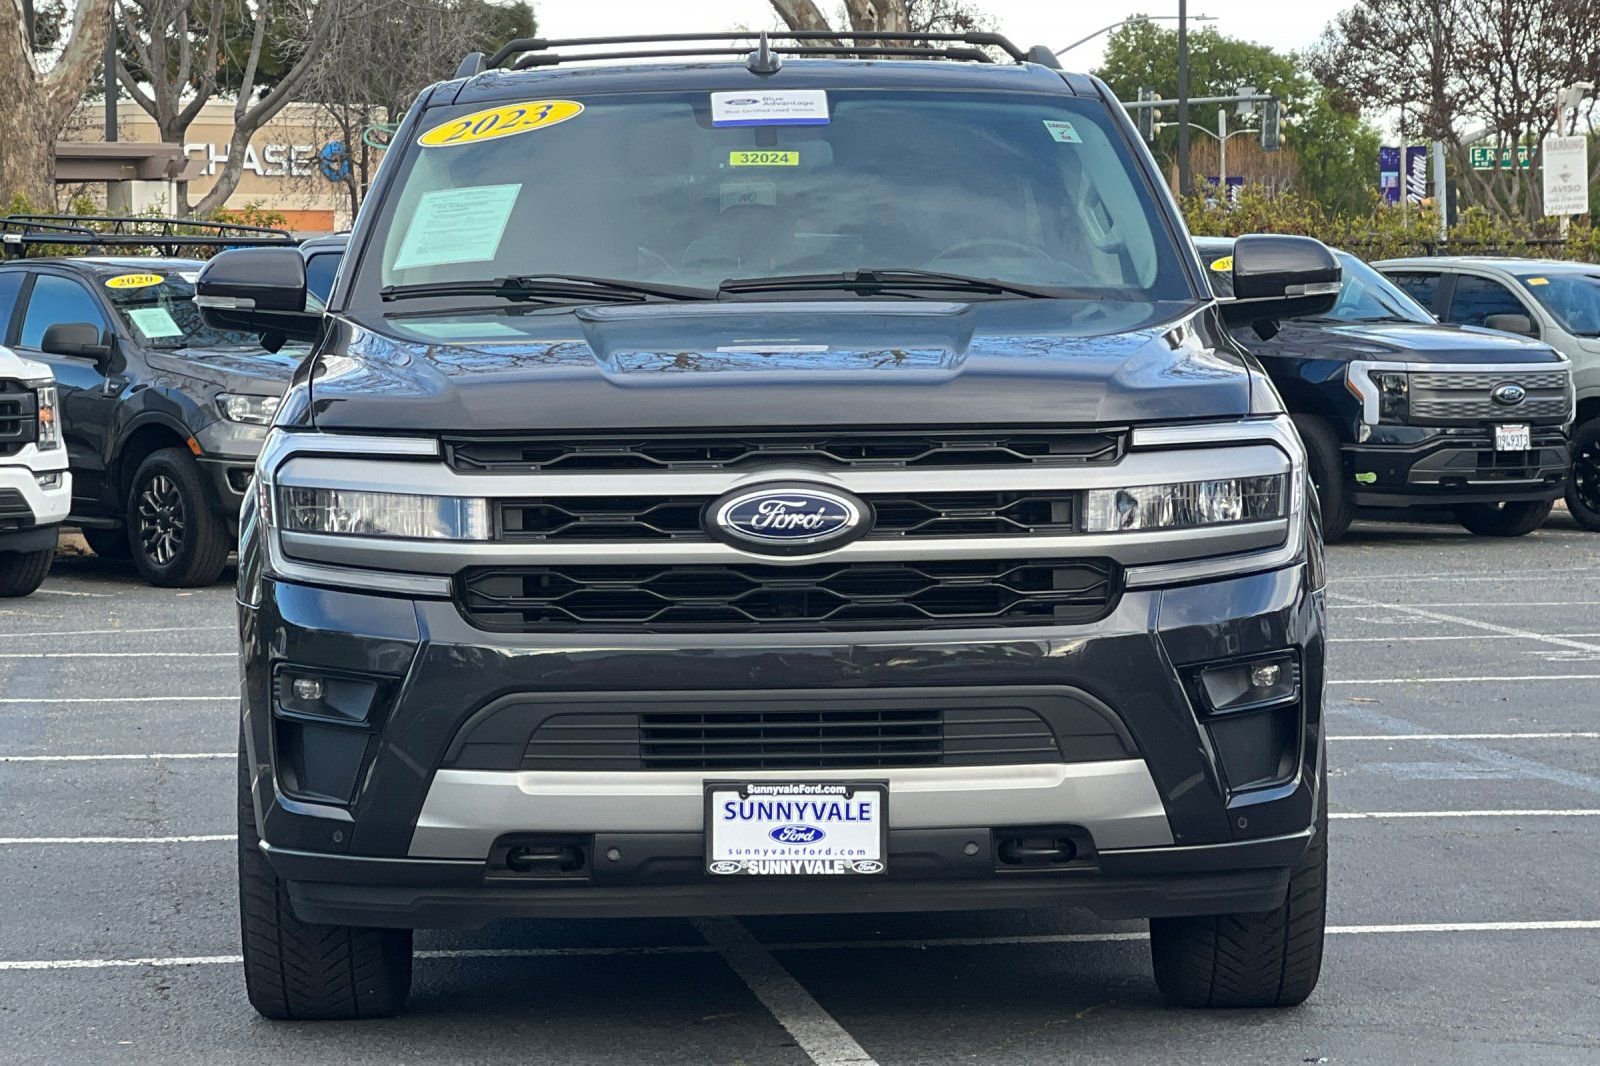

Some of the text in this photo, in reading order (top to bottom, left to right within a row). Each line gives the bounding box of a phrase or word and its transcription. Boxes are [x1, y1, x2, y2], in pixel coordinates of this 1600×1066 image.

[443, 104, 553, 143] 2023
[1545, 138, 1584, 152] WARNING
[740, 152, 790, 164] 32024
[1474, 149, 1485, 161] E.
[1550, 184, 1582, 194] AVISO
[118, 275, 154, 286] 2020
[751, 500, 826, 530] Ford
[746, 783, 847, 796] SunnyvaleFord.com
[724, 801, 872, 821] SUNNYVALE
[778, 826, 815, 841] Ford
[727, 847, 867, 857] sunnyvaleford.com
[714, 862, 736, 872] Ford
[747, 860, 845, 875] SUNNYVALE
[857, 862, 879, 872] Ford
